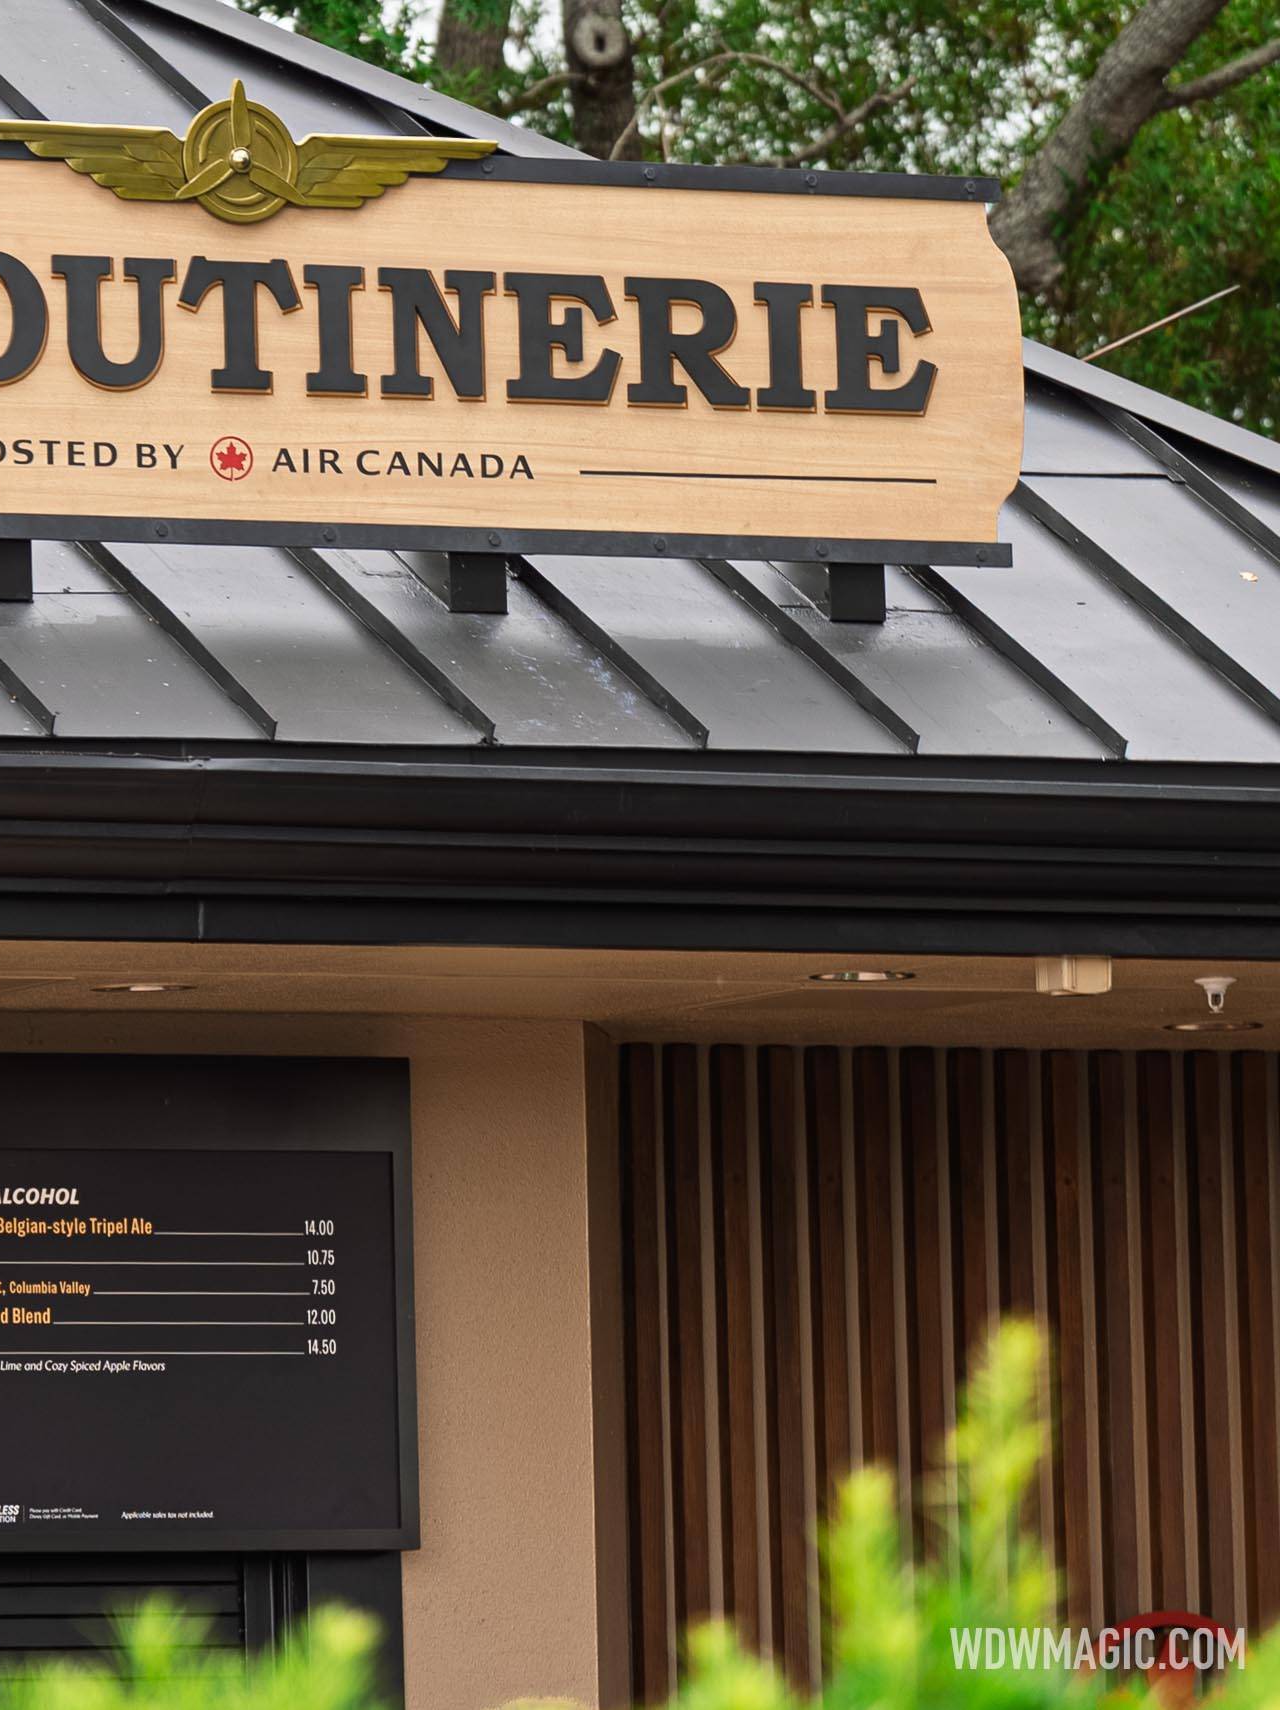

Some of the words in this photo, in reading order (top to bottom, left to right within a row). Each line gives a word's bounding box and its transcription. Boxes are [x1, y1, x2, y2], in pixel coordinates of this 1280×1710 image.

[136, 443, 185, 471] BY
[272, 447, 342, 475] AIR
[356, 448, 535, 480] CANADA
[90, 1218, 127, 1237] Tripel
[131, 1218, 152, 1234] Ale
[305, 1220, 334, 1235] 14.00
[308, 1250, 334, 1265] 10.75
[10, 1281, 57, 1294] Columbia
[60, 1281, 90, 1296] Valley
[312, 1280, 335, 1295] 7.50
[13, 1308, 50, 1324] Blend
[307, 1309, 336, 1324] 12.00
[308, 1339, 336, 1354] 14.50
[0, 1361, 21, 1371] Lime
[24, 1361, 42, 1371] and
[45, 1361, 68, 1372] Cozy
[70, 1360, 101, 1373] Spiced
[103, 1361, 130, 1373] Apple
[133, 1361, 165, 1371] Flavors
